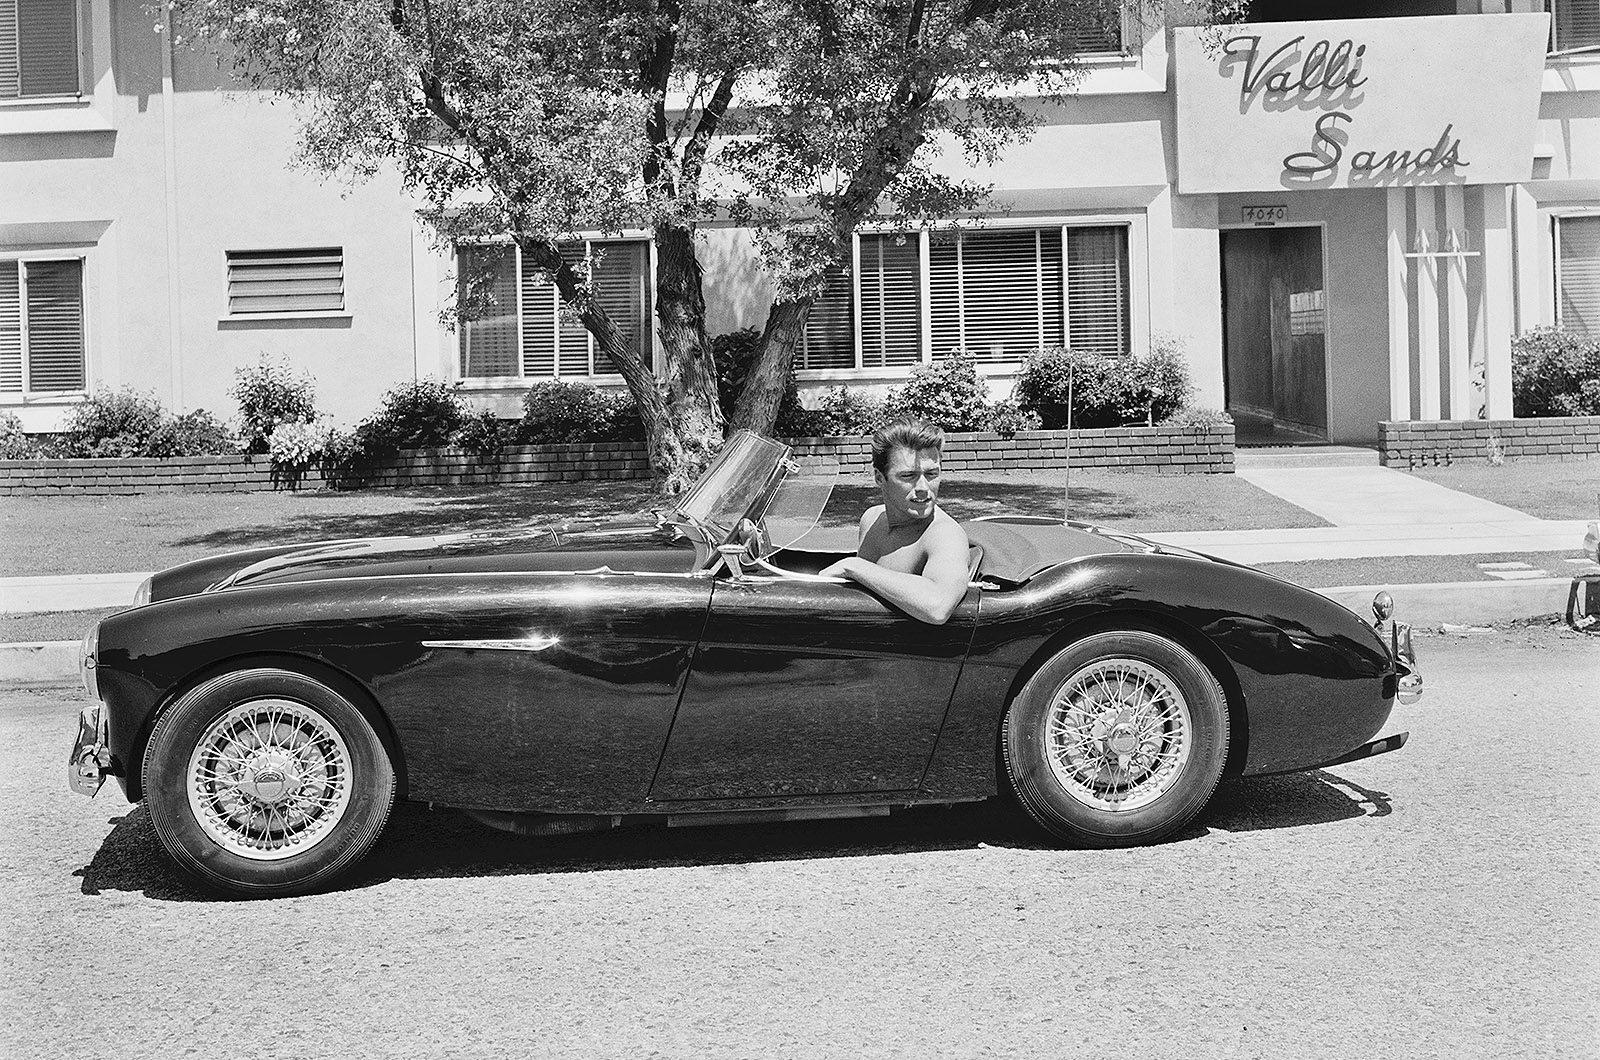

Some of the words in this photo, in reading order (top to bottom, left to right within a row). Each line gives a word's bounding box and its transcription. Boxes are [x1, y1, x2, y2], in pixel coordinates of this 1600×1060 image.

[1222, 35, 1369, 93] Valli
[1283, 111, 1471, 173] Sands
[1246, 207, 1284, 220] 4040
